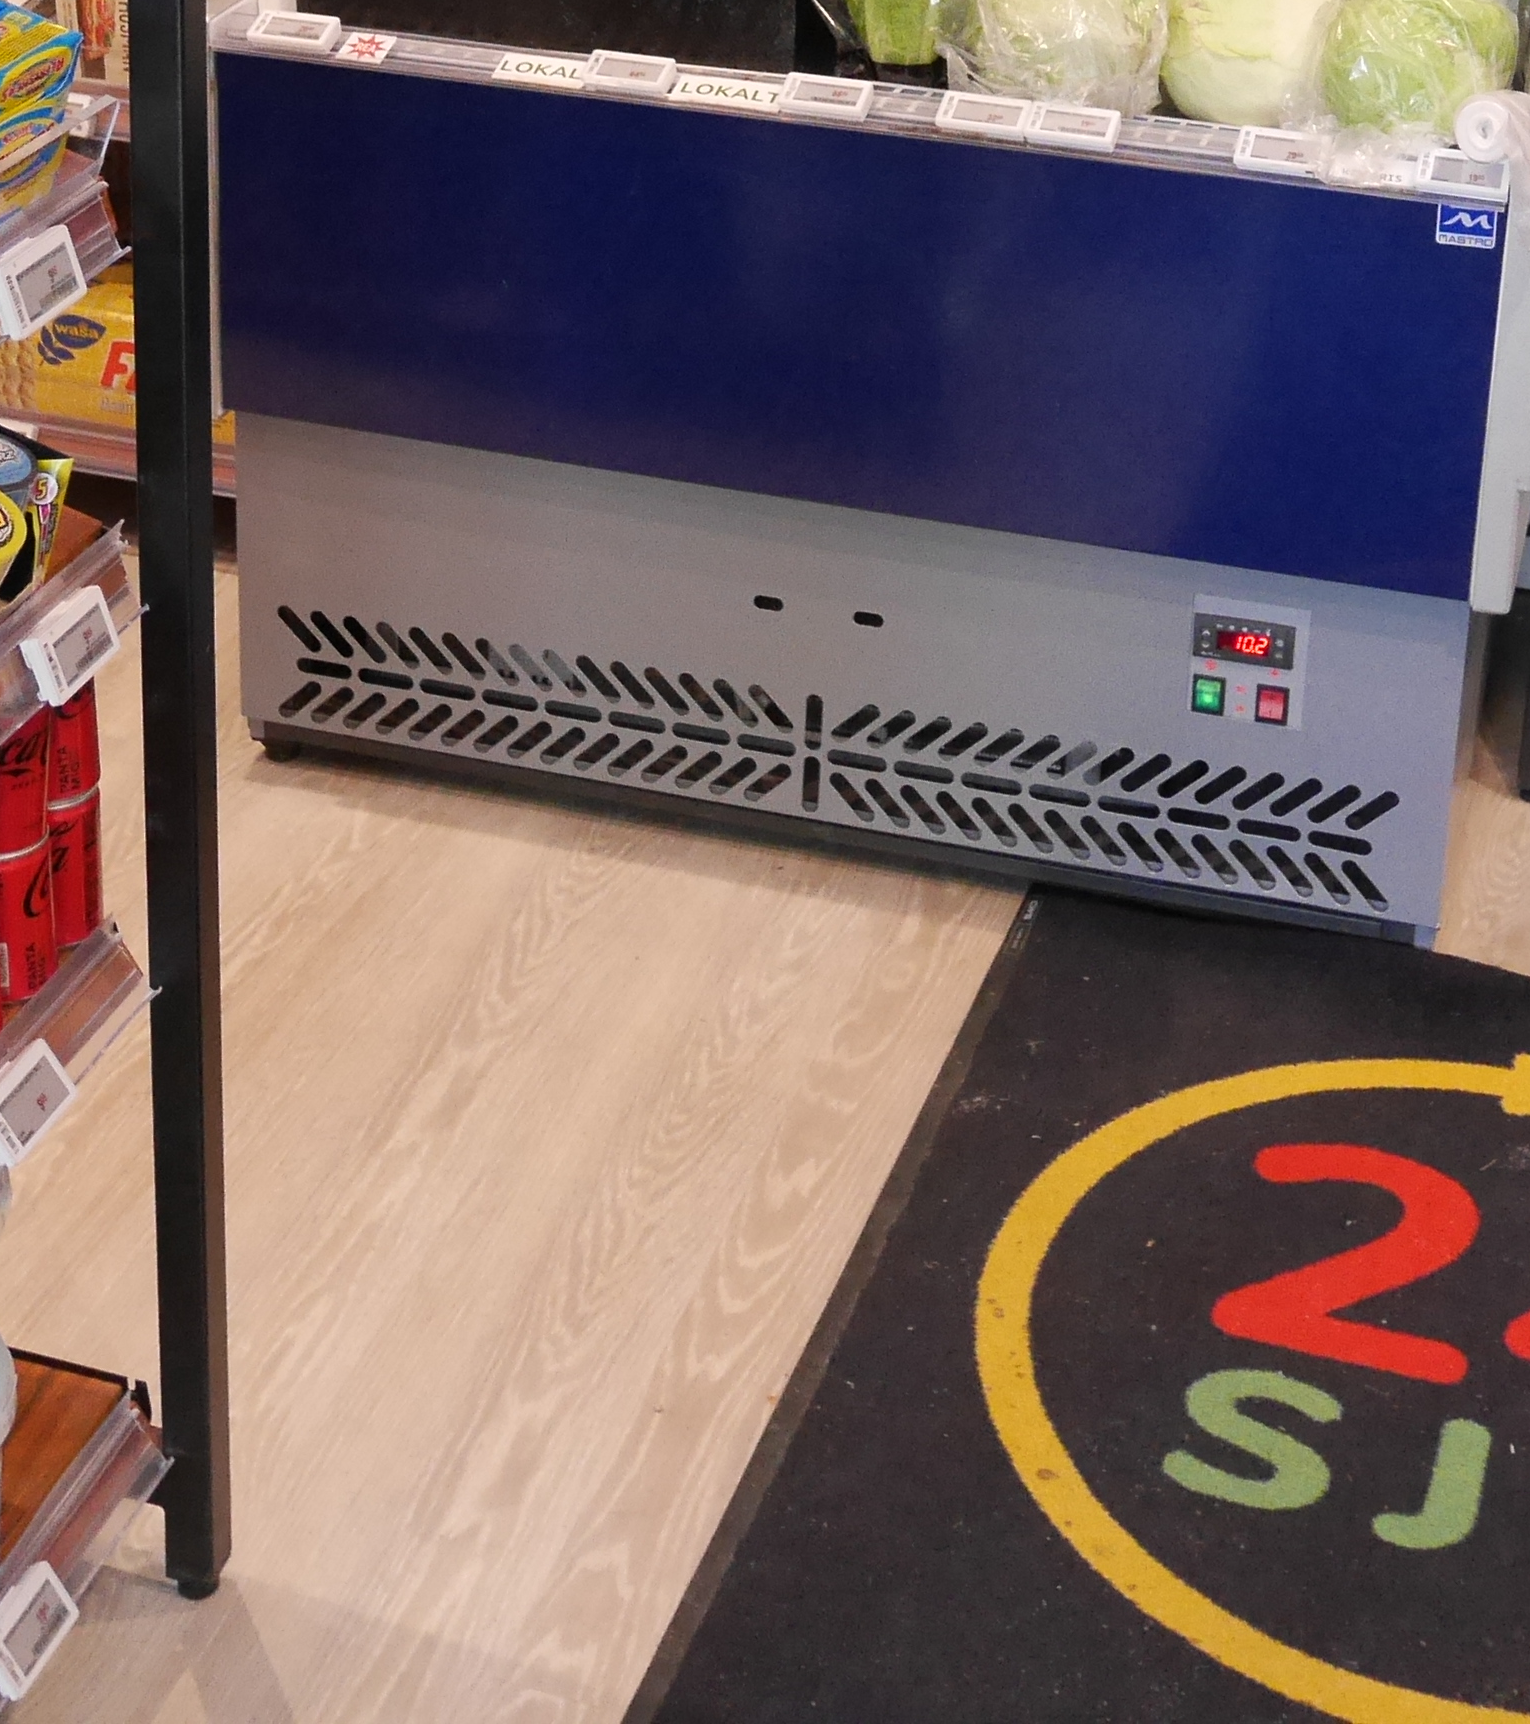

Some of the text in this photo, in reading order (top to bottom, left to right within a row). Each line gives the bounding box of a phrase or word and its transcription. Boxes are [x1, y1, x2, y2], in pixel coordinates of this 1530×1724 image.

[680, 82, 780, 105] LOKALT
[1438, 234, 1494, 245] MASTRO
[54, 321, 97, 338] wasa
[36, 479, 48, 499] 5
[1235, 636, 1269, 655] 10.2
